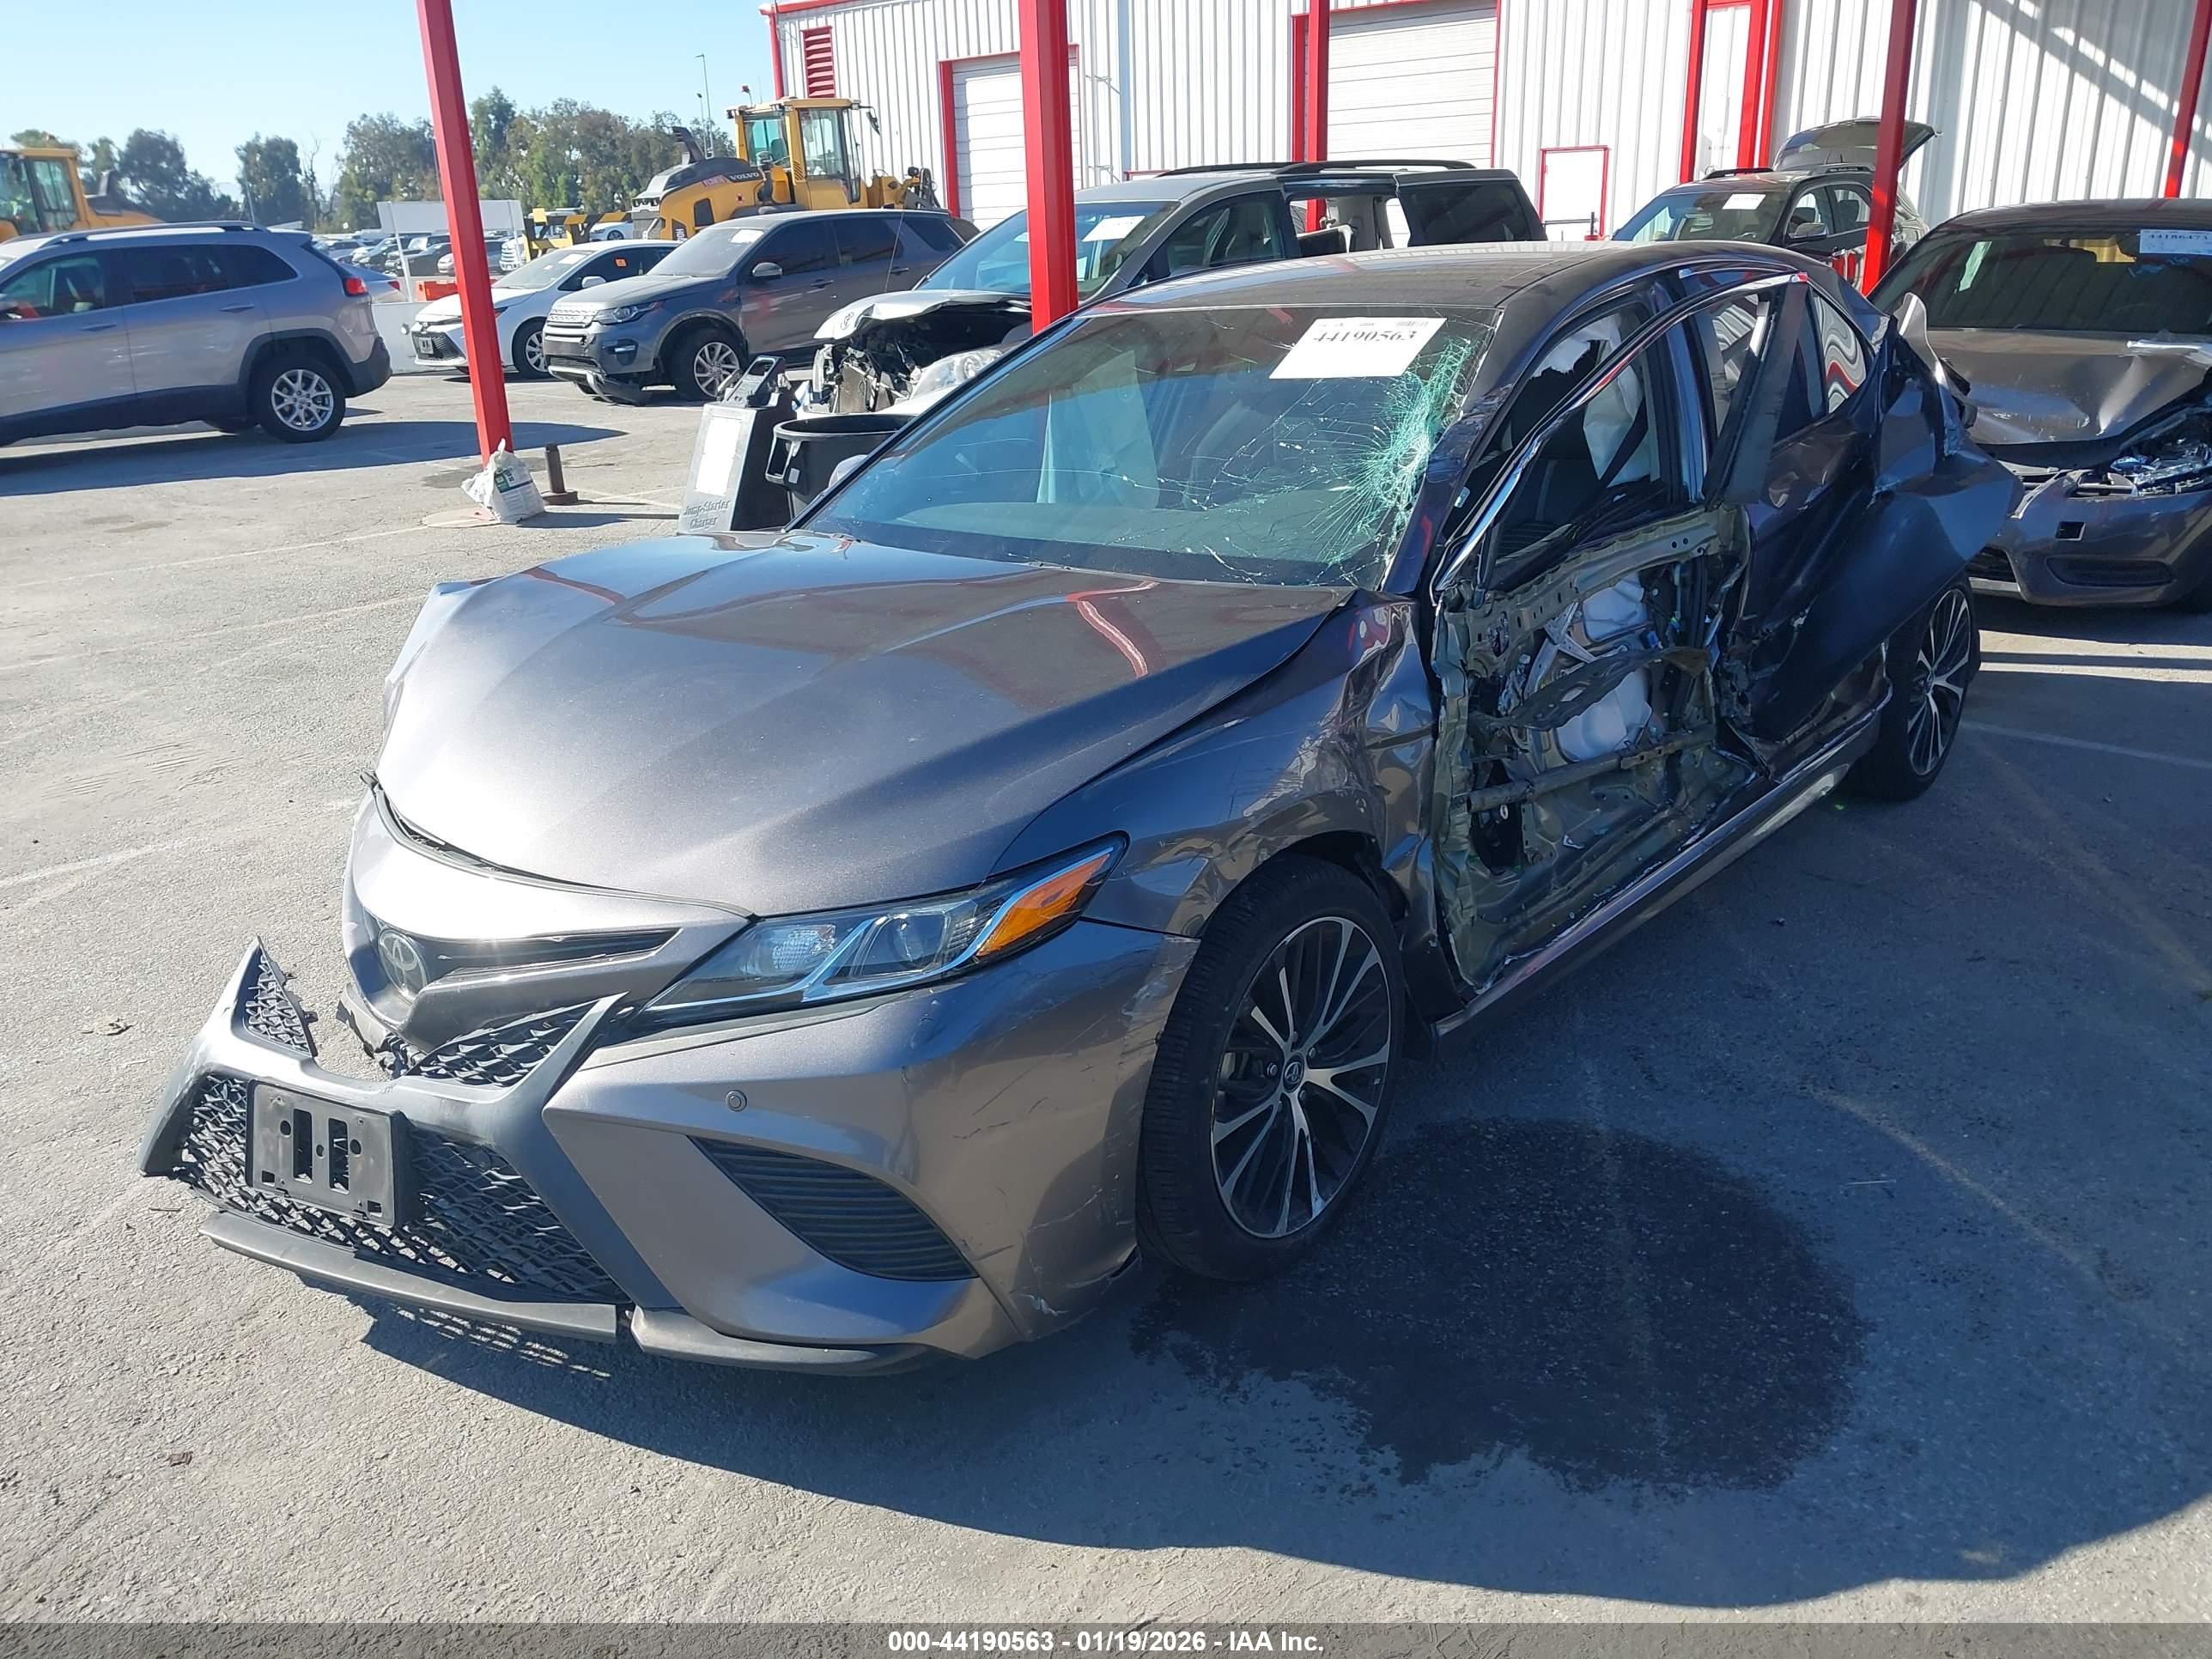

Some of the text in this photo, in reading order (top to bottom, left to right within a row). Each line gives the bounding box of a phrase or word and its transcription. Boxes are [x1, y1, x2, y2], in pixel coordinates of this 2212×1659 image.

[729, 172, 760, 181] VOLVO
[1313, 330, 1418, 343] 44190563
[690, 517, 718, 529] Charger
